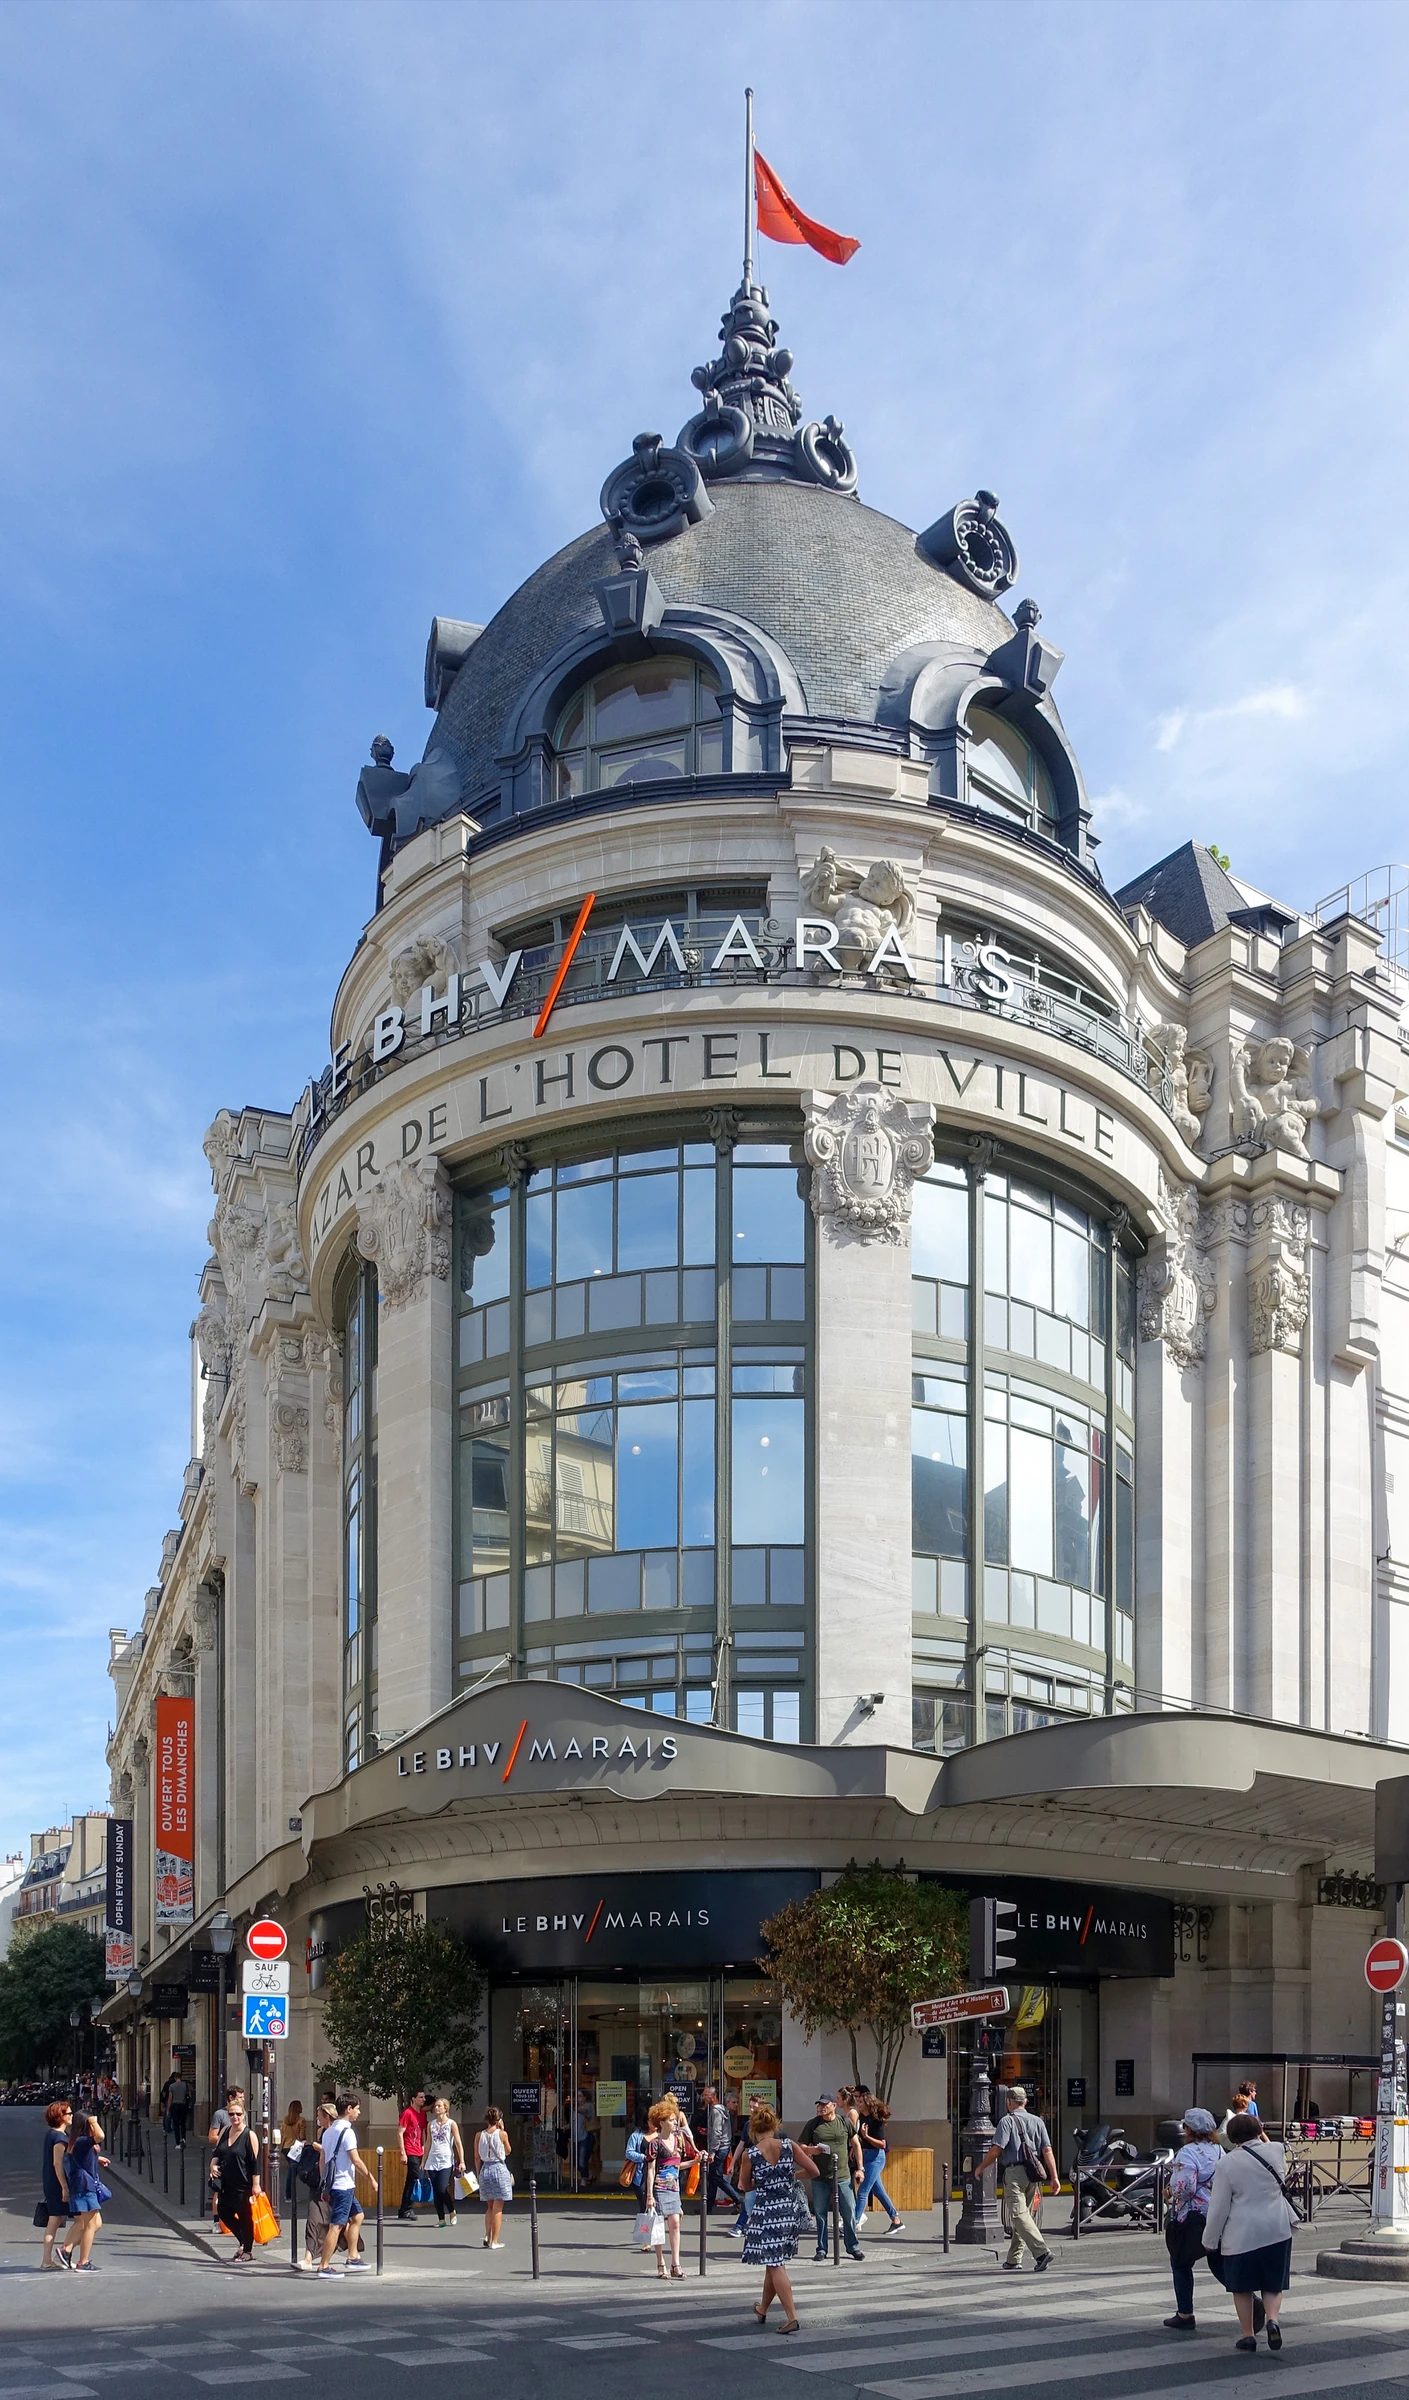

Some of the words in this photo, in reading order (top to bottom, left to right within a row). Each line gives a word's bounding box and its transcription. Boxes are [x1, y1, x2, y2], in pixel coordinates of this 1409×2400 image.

[309, 1039, 351, 1129] LE
[373, 949, 523, 1064] BHV
[607, 914, 1016, 1000] MARAIS
[311, 1140, 380, 1252] AZAR
[401, 1102, 448, 1160] DE
[478, 1032, 792, 1124] L'HOTEL
[832, 1044, 902, 1088] DE
[936, 1049, 1114, 1160] VILLE
[163, 1736, 173, 1773] TOUS
[176, 1720, 188, 1803] DIMANCHES
[398, 1751, 424, 1776] LE
[436, 1742, 501, 1770] BHV
[529, 1736, 678, 1762] MARAIS
[162, 1777, 173, 1832] OUVERT
[176, 1808, 187, 1832] LES
[115, 1823, 124, 1863] SUNDAY
[115, 1864, 124, 1899] EVERY
[115, 1899, 124, 1926] OPEN
[502, 1917, 526, 1933] LE
[536, 1914, 584, 1931] BHV
[605, 1909, 710, 1929] MARAIS
[1017, 1912, 1038, 1928] LE
[1046, 1915, 1082, 1931] BHV
[1095, 1919, 1147, 1939] MARAIS
[254, 1963, 279, 1972] SAUF
[272, 2023, 281, 2031] 20
